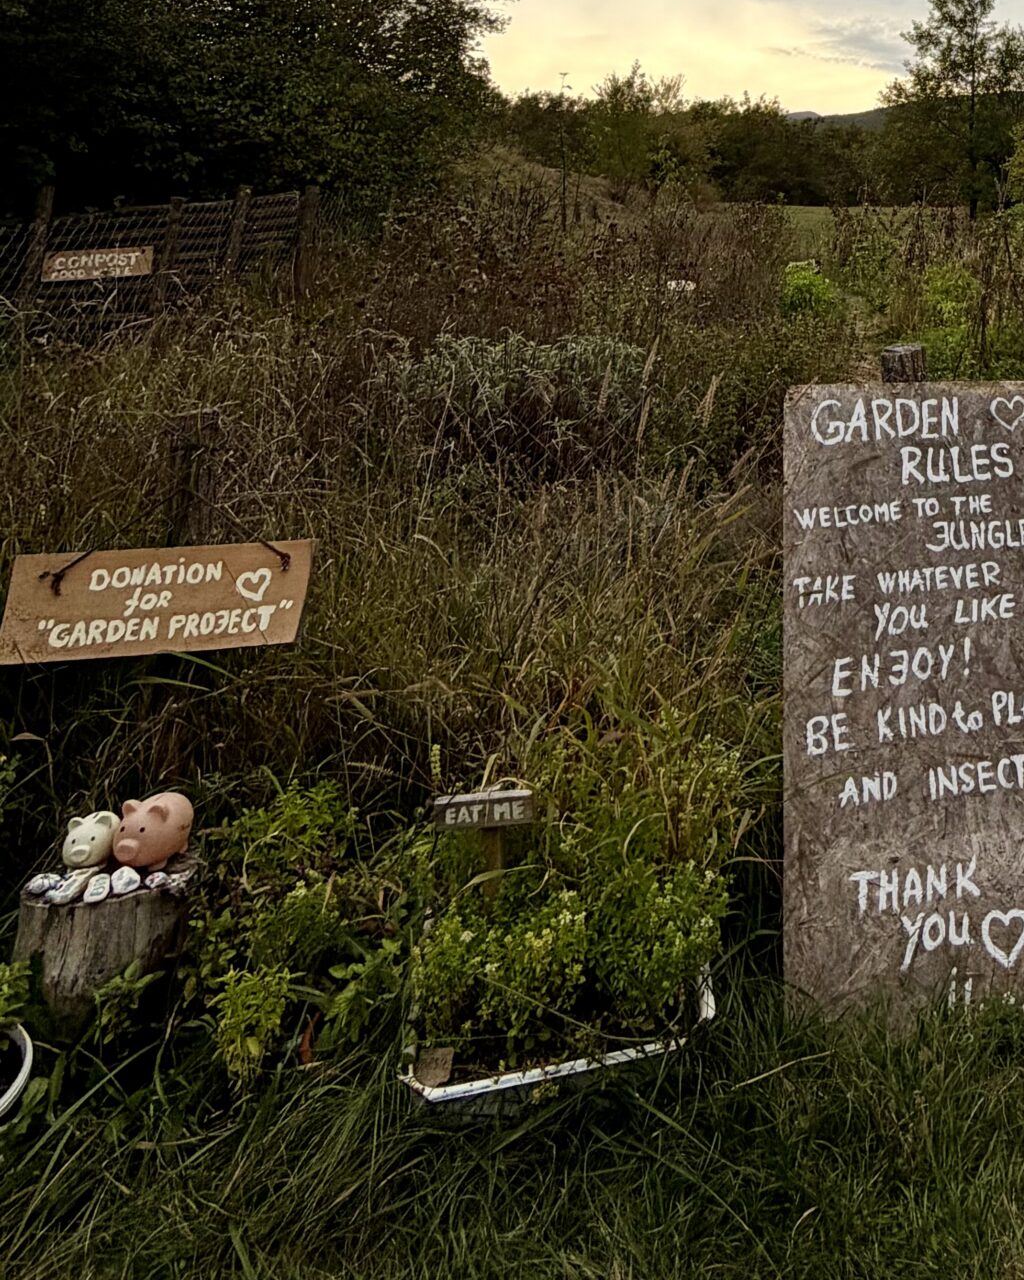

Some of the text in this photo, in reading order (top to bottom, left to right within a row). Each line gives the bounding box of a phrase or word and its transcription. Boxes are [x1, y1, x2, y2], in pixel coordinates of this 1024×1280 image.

[54, 253, 140, 270] COMPOST
[811, 396, 959, 446] GARDEN
[901, 442, 1014, 485] RULES
[794, 494, 992, 530] WELCOME TO THE
[793, 561, 1001, 608] TAKE WHATEVER
[37, 599, 294, 649] "GARDEN PROJECT"
[874, 602, 929, 641] YOU
[832, 636, 971, 697] ENJOY!
[806, 712, 854, 756] BE
[877, 702, 947, 743] KIND
[952, 701, 983, 733] to
[445, 801, 525, 825] EAT ME
[839, 771, 897, 808] AND
[849, 854, 981, 915] THANK
[900, 910, 975, 971] YOU
